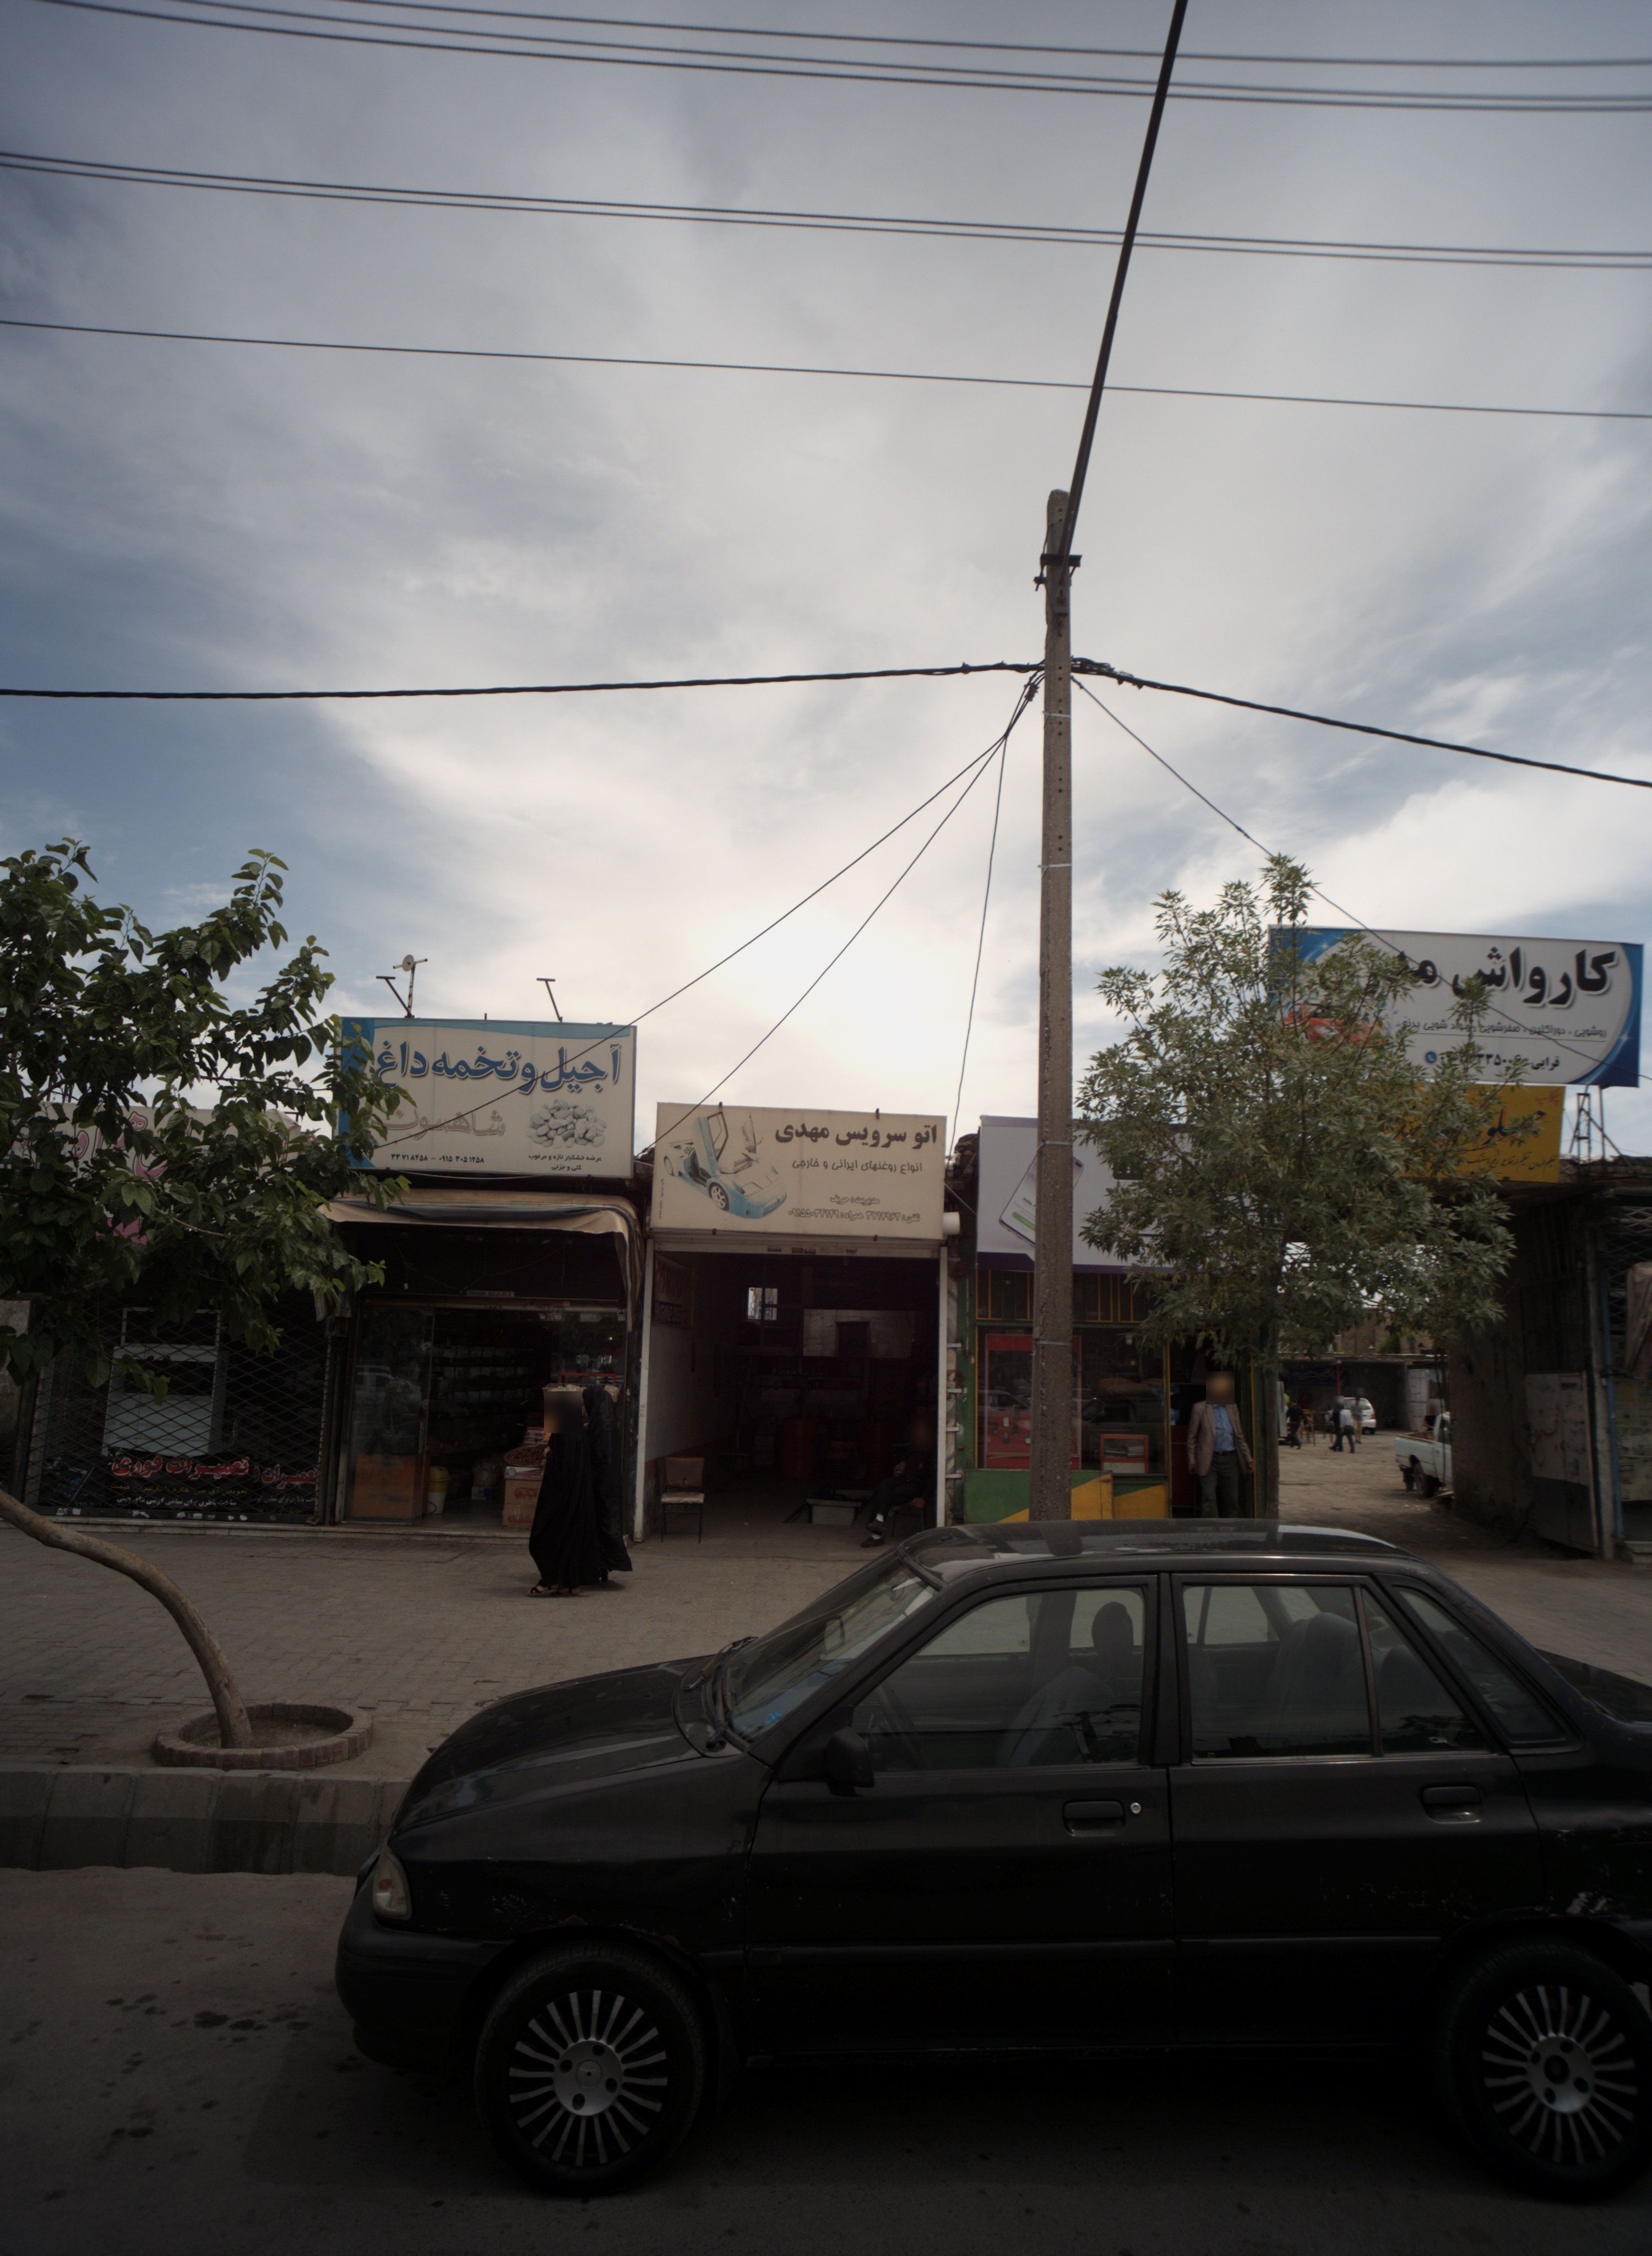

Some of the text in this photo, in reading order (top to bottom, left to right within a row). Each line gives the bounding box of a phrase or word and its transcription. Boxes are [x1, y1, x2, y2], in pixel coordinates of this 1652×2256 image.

[374, 1040, 621, 1094] آجیل و تخمه داغ
[775, 1122, 937, 1149] اتو سرویس مهدی
[792, 1158, 820, 1170] خارجی
[823, 1161, 828, 1170] و
[832, 1159, 858, 1172] ایرانی
[900, 1162, 923, 1174] انواع
[111, 1455, 164, 1478] فوری
[166, 1455, 249, 1481] تعمیرات
